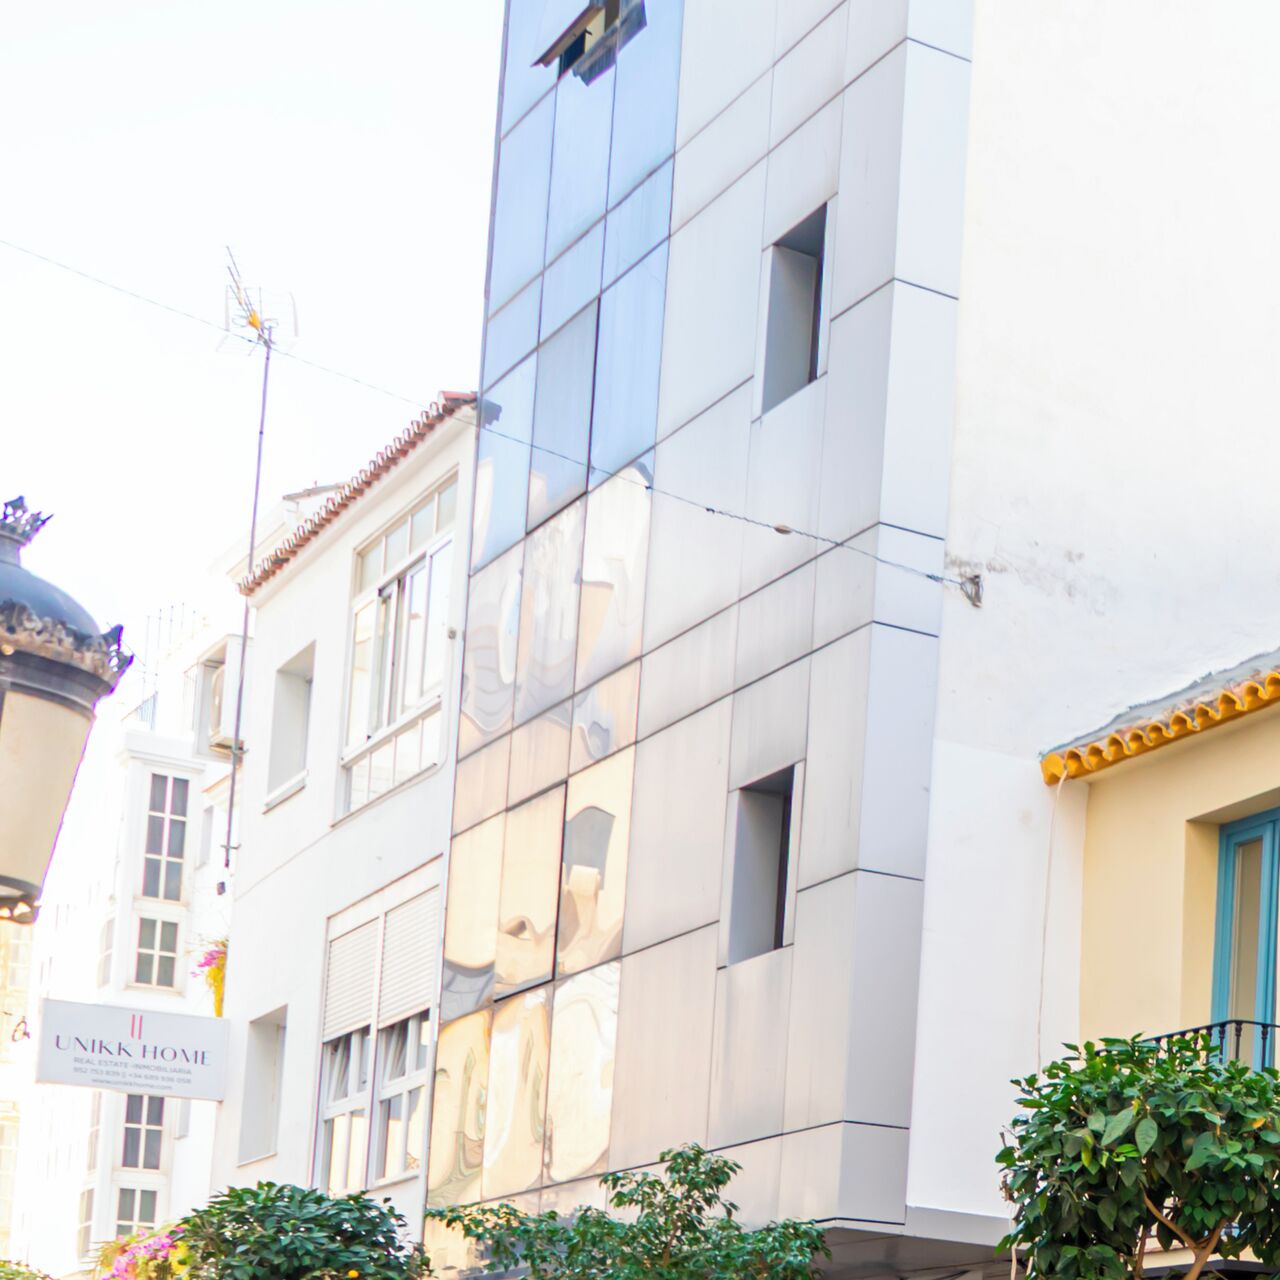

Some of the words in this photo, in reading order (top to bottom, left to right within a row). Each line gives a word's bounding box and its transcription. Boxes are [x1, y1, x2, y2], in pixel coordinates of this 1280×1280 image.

[55, 1034, 132, 1058] UNIKK
[142, 1044, 211, 1066] HOME
[73, 1056, 96, 1066] REAL
[98, 1059, 129, 1070] ESTATE
